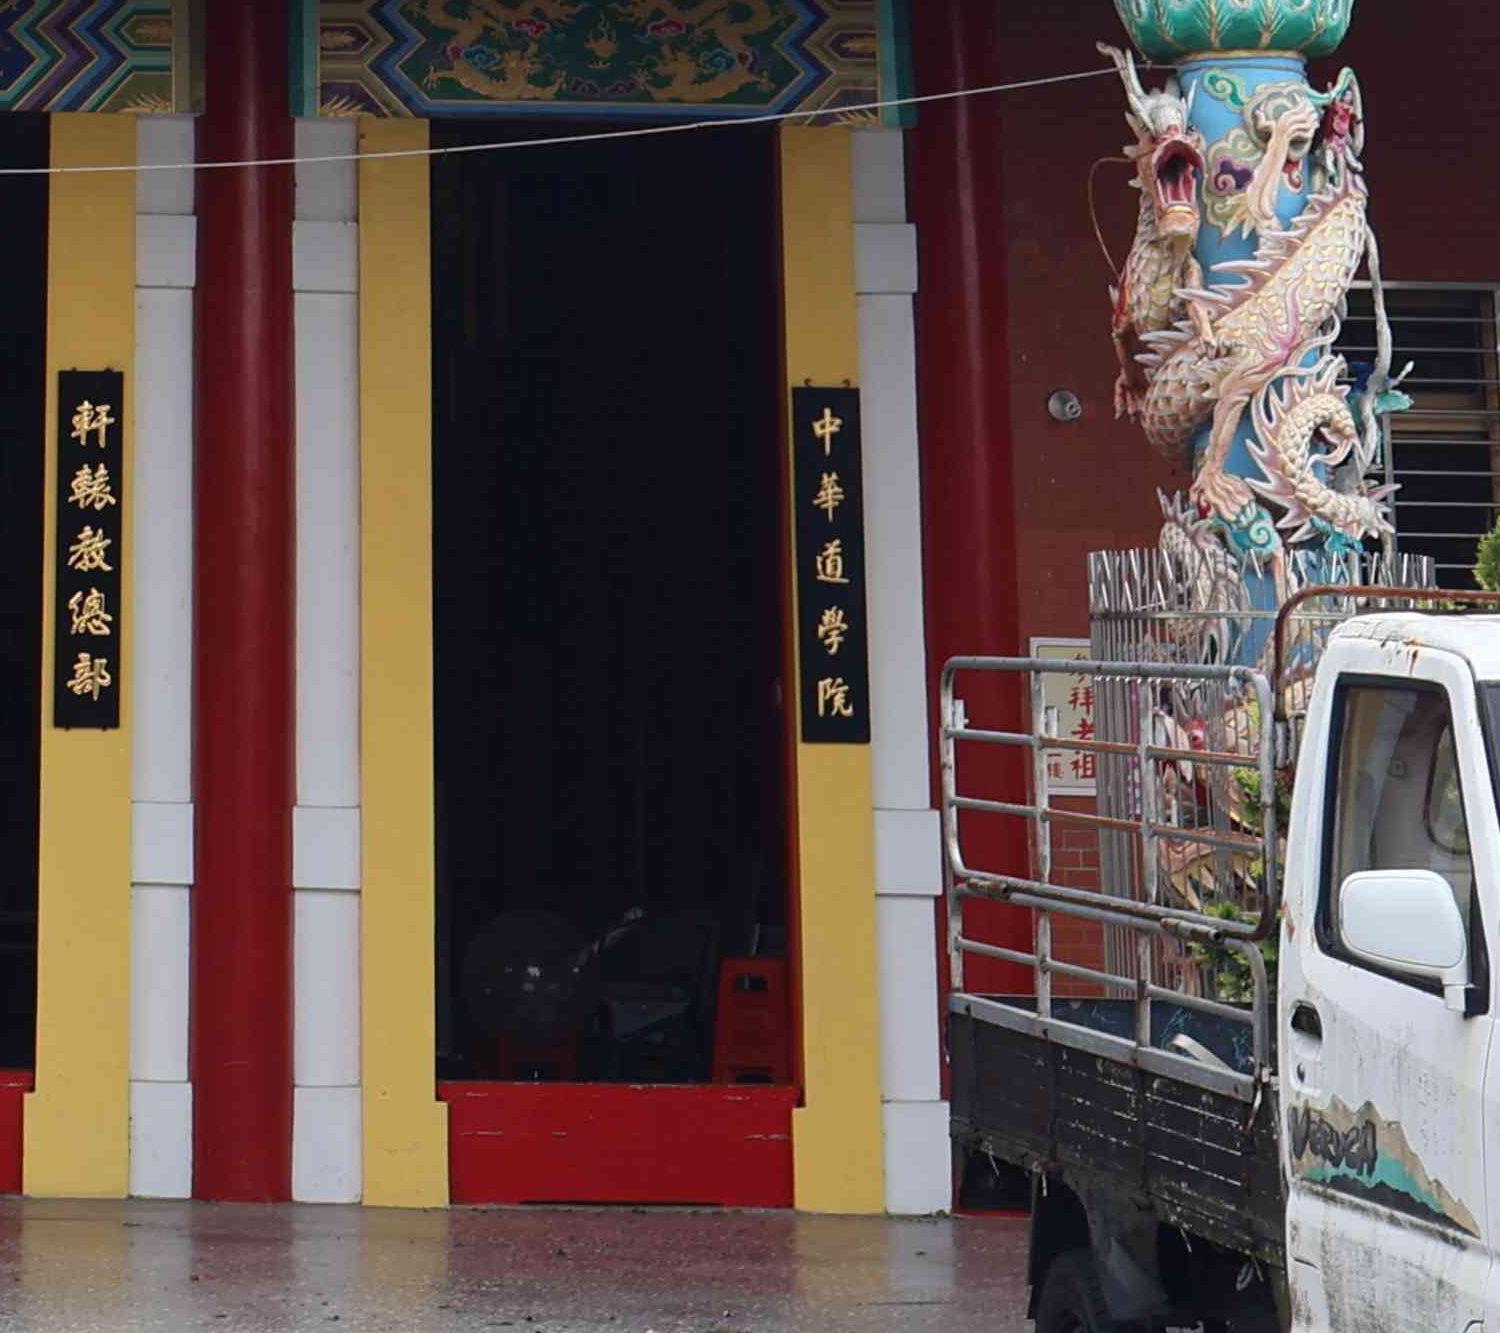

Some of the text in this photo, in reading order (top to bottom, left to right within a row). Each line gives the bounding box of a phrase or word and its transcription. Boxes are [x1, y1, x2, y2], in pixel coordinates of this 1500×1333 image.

[812, 407, 854, 717] 中華道學院
